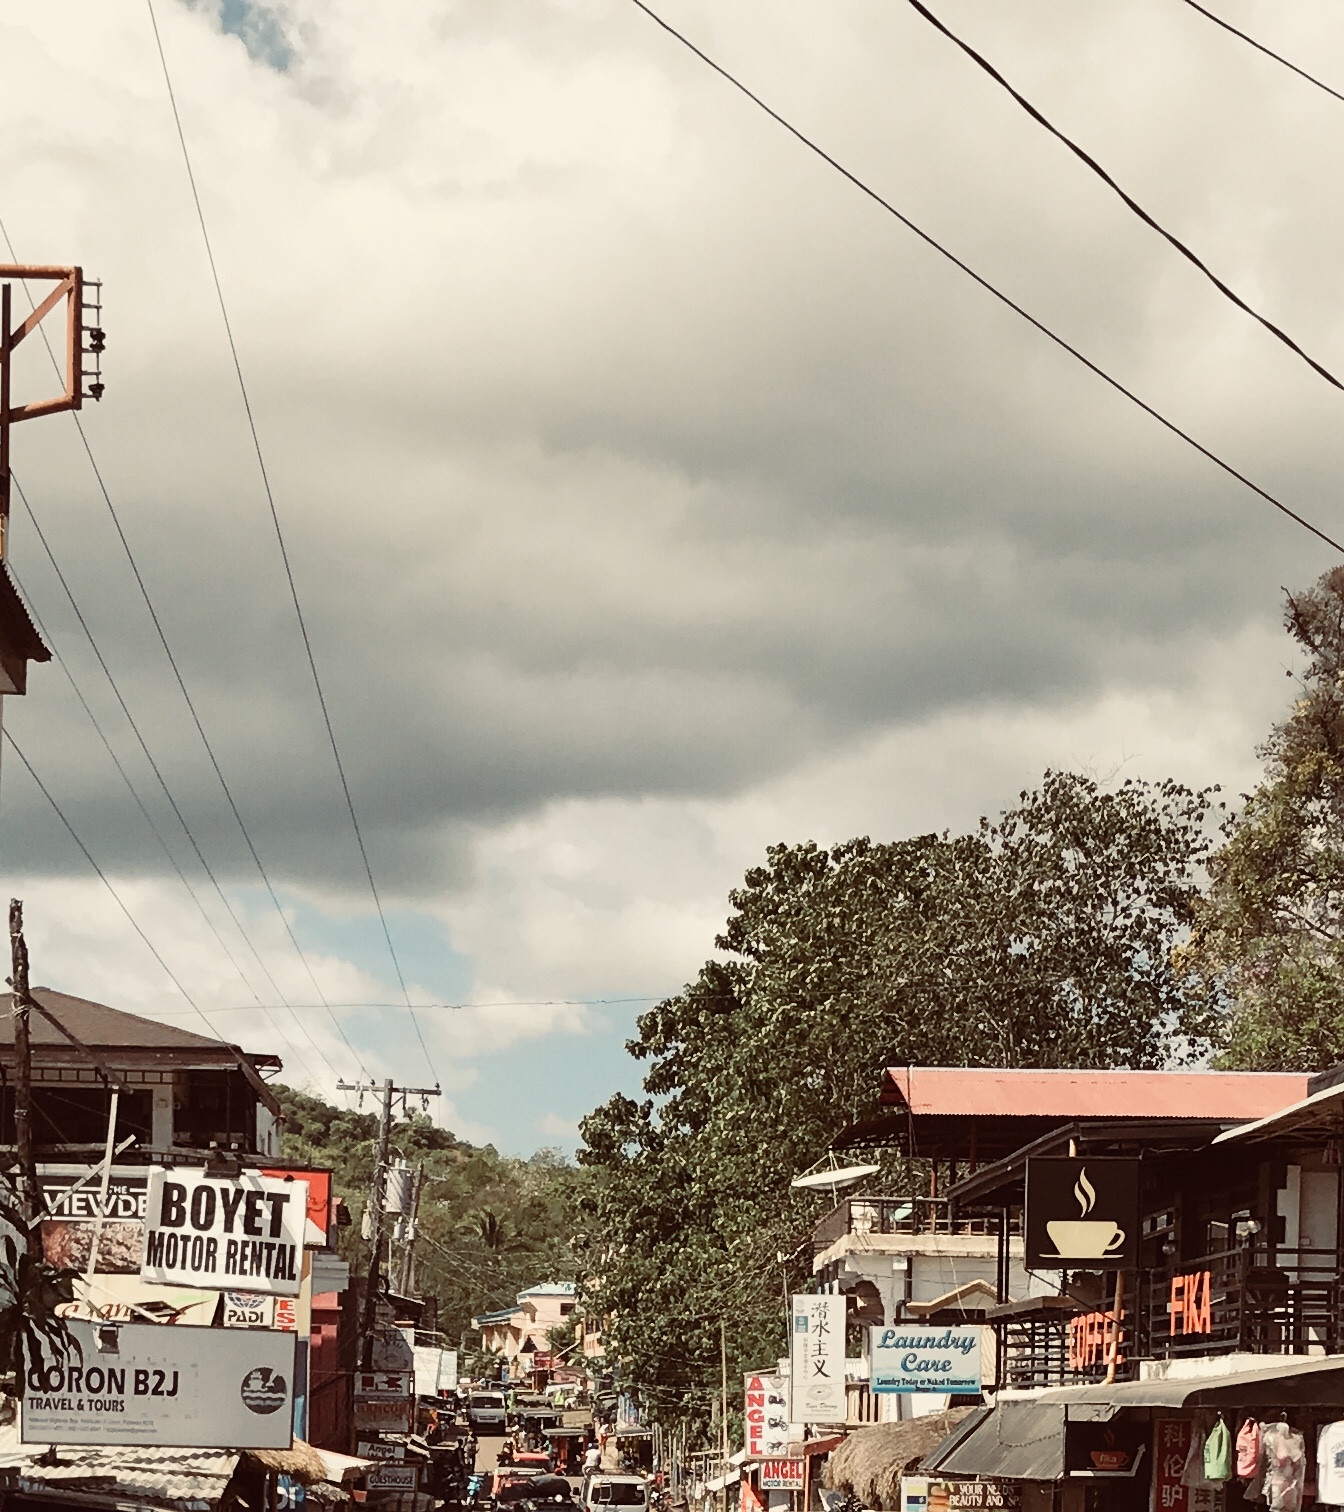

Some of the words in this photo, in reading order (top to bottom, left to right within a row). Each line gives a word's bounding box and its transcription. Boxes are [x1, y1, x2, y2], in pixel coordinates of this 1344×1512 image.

[160, 1181, 290, 1238] BOYET
[146, 1230, 218, 1272] MOTOR
[224, 1238, 296, 1281] RENTAL
[1170, 1272, 1213, 1337] FIKA
[228, 1310, 264, 1323] PADI
[811, 1301, 831, 1378] 潜水主义
[877, 1329, 976, 1355] Laundry
[901, 1353, 952, 1372] Care
[27, 1366, 126, 1395] CORON
[134, 1369, 179, 1397] B2J
[29, 1397, 74, 1411] TRAVEL
[77, 1399, 85, 1411] &
[87, 1399, 125, 1412] TOURS
[746, 1376, 765, 1456] ANGEL
[764, 1461, 803, 1479] ANGEL
[763, 1479, 782, 1488] MOTOR
[783, 1480, 803, 1488] RENTAL
[959, 1484, 983, 1495] YOUR
[949, 1495, 983, 1506] BEAUTY
[986, 1496, 1004, 1507] AND
